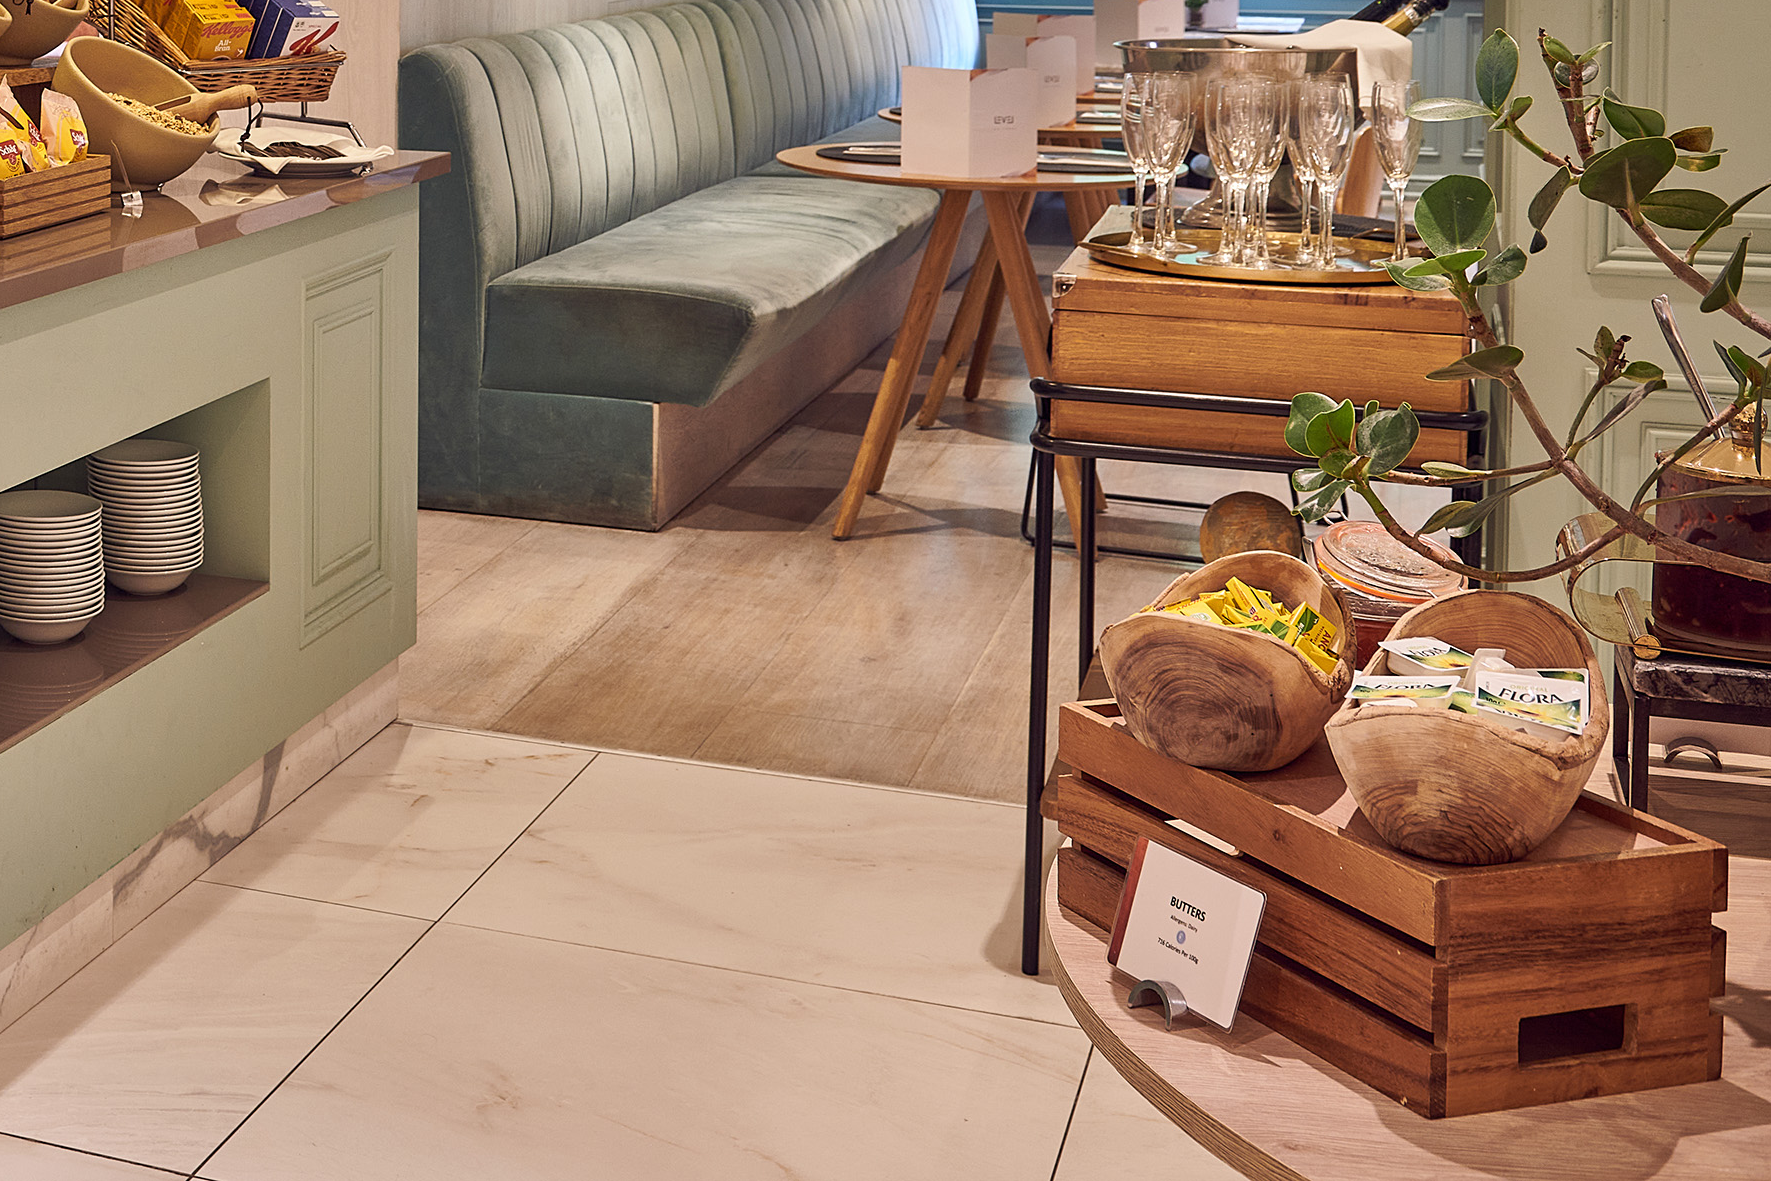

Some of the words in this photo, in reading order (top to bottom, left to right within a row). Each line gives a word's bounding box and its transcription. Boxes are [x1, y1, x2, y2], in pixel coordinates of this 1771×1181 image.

[200, 20, 254, 38] Kellogg's
[1498, 688, 1564, 704] FLORA
[1170, 896, 1206, 922] BUTTERS
[1165, 942, 1181, 954] Calories
